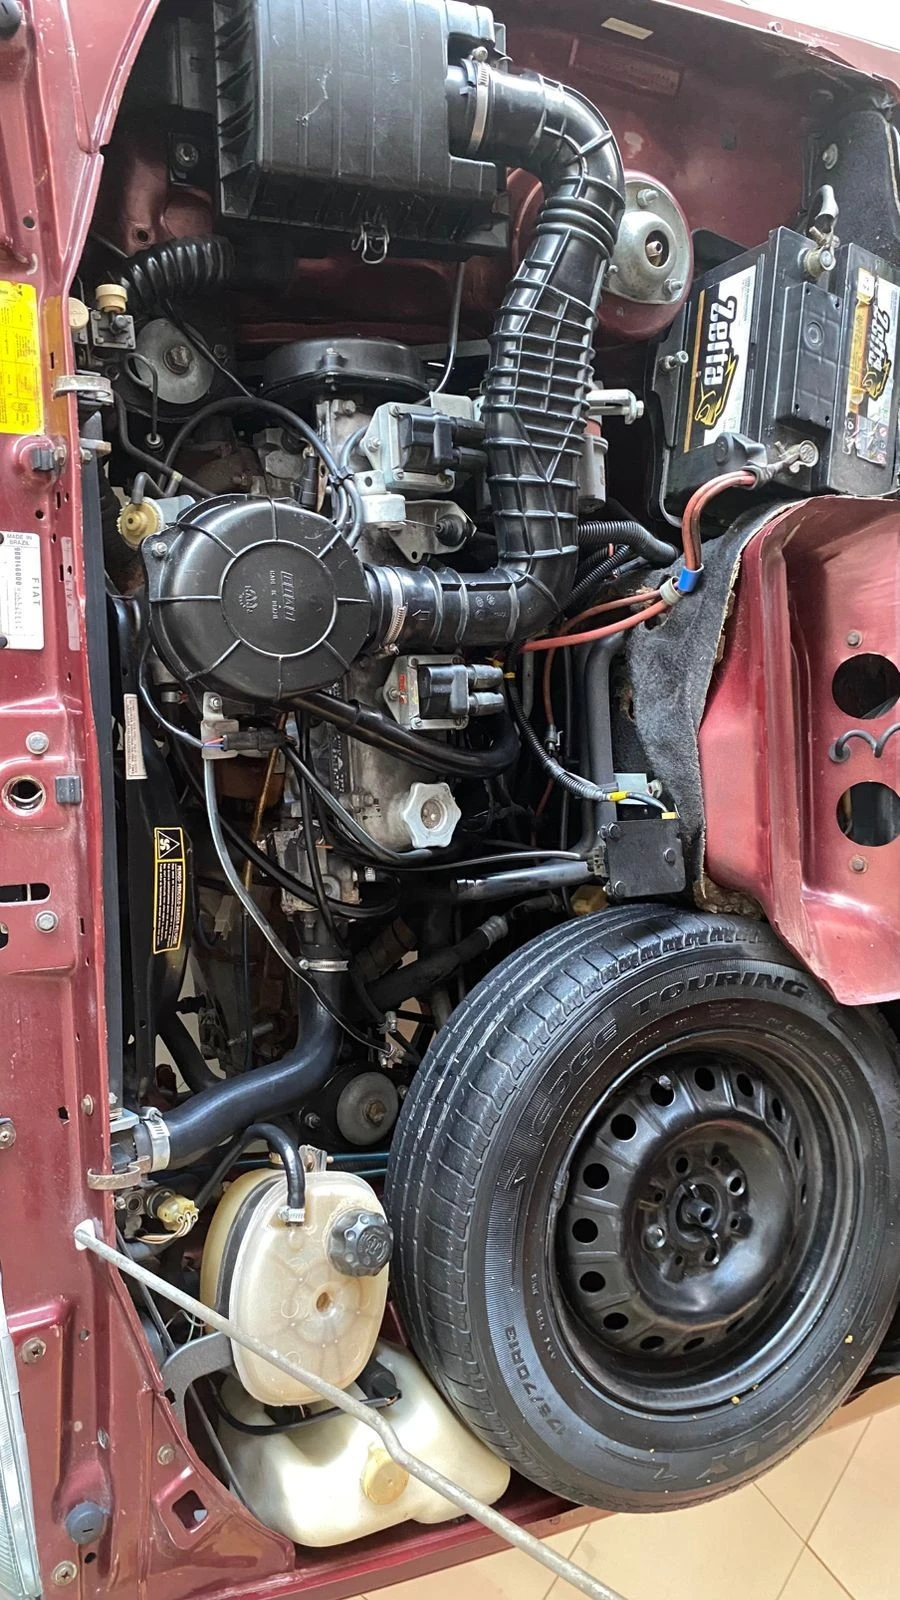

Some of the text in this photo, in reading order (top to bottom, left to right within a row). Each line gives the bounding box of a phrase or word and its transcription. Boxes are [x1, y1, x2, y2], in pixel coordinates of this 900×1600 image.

[704, 298, 736, 386] Zetta
[32, 577, 40, 606] FIAT
[532, 970, 809, 1136] EDGE TOURING
